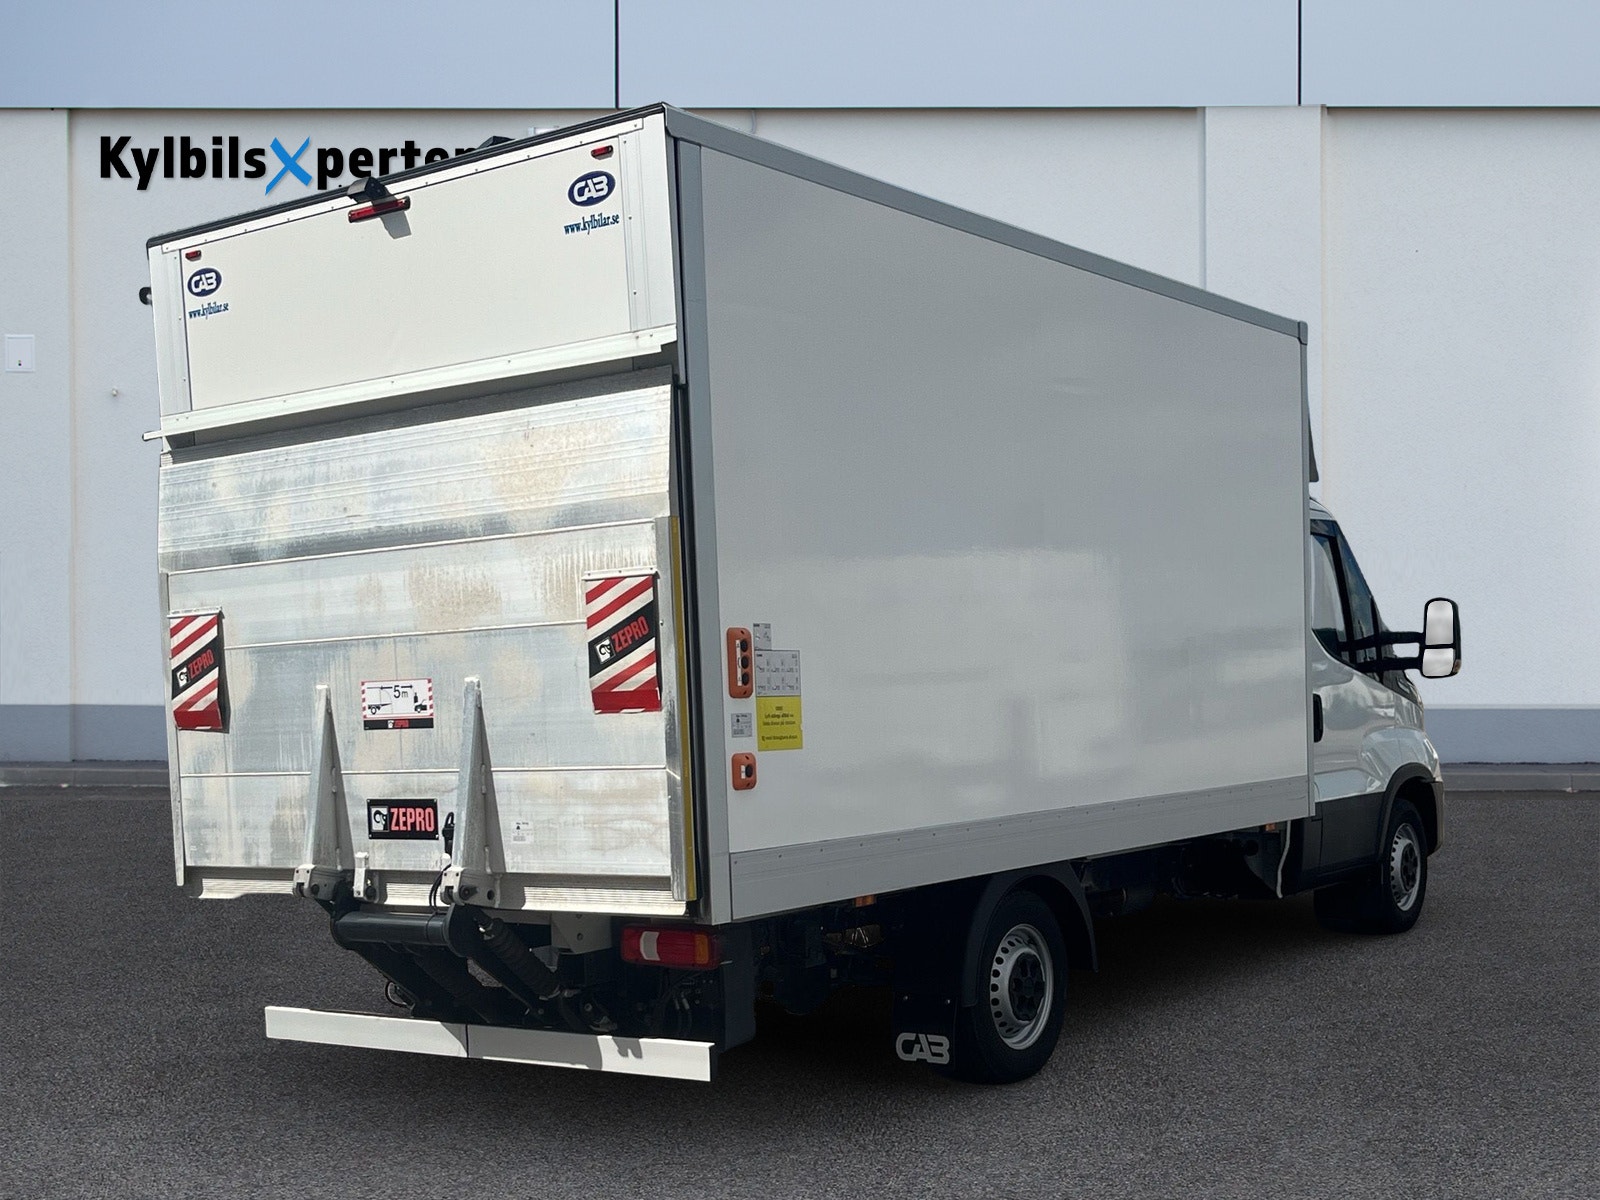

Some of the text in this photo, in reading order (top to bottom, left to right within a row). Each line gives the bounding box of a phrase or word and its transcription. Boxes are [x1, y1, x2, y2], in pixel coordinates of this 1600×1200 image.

[573, 175, 609, 203] CAB
[563, 212, 620, 235] www.kylbilar.se
[191, 272, 217, 293] CAB
[611, 615, 649, 653] ZEPRO
[187, 649, 215, 679] ZEPRO
[390, 807, 435, 832] ZEPRO
[895, 1032, 950, 1065] CAB
